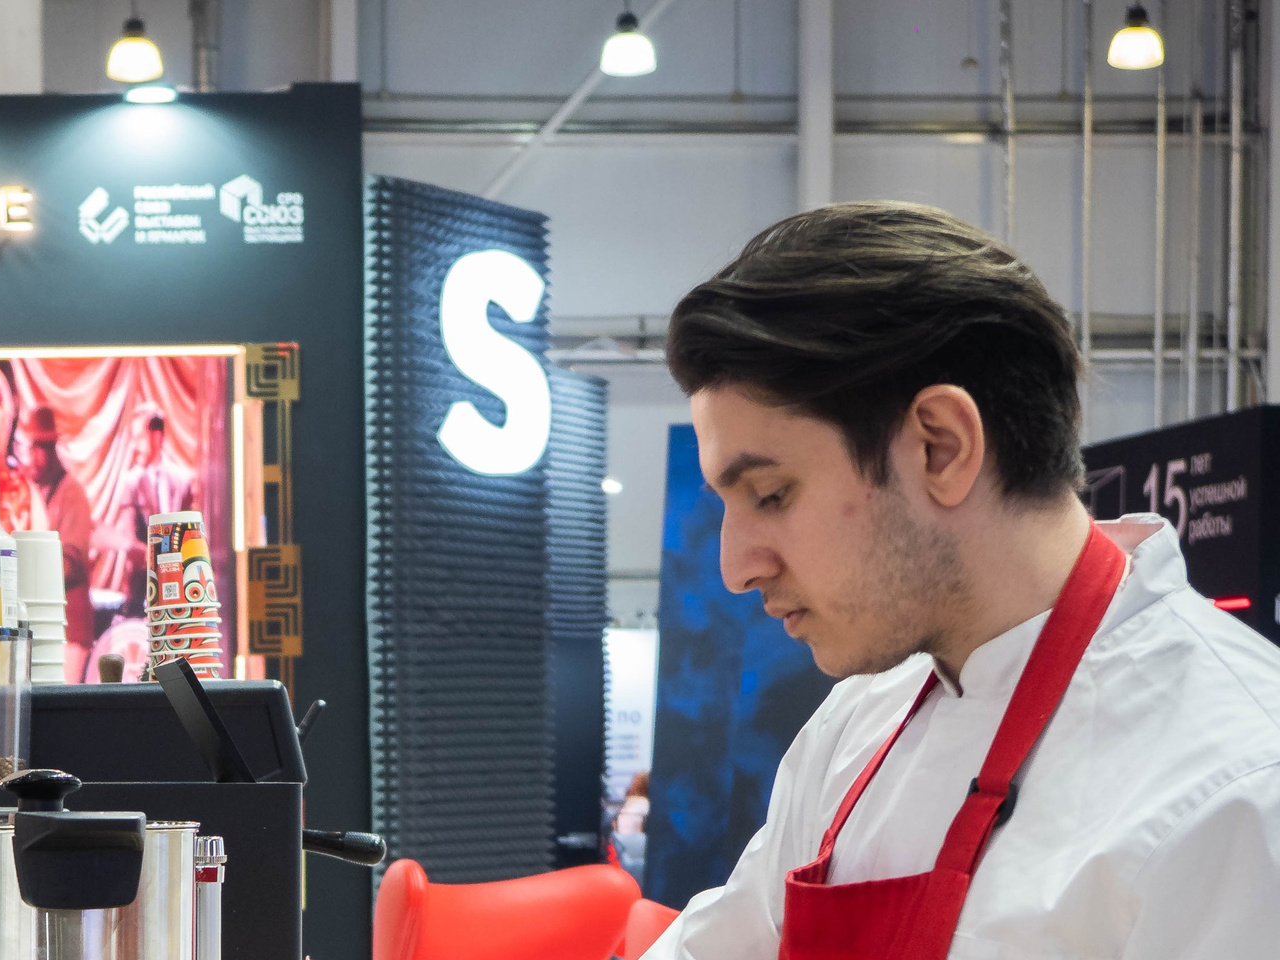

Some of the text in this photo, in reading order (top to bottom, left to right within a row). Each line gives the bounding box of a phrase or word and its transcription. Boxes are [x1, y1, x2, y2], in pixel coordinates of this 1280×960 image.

[436, 249, 551, 476] S
[1142, 453, 1212, 542] 15 лет
[1189, 475, 1248, 513] успешной
[1188, 512, 1233, 545] работы
